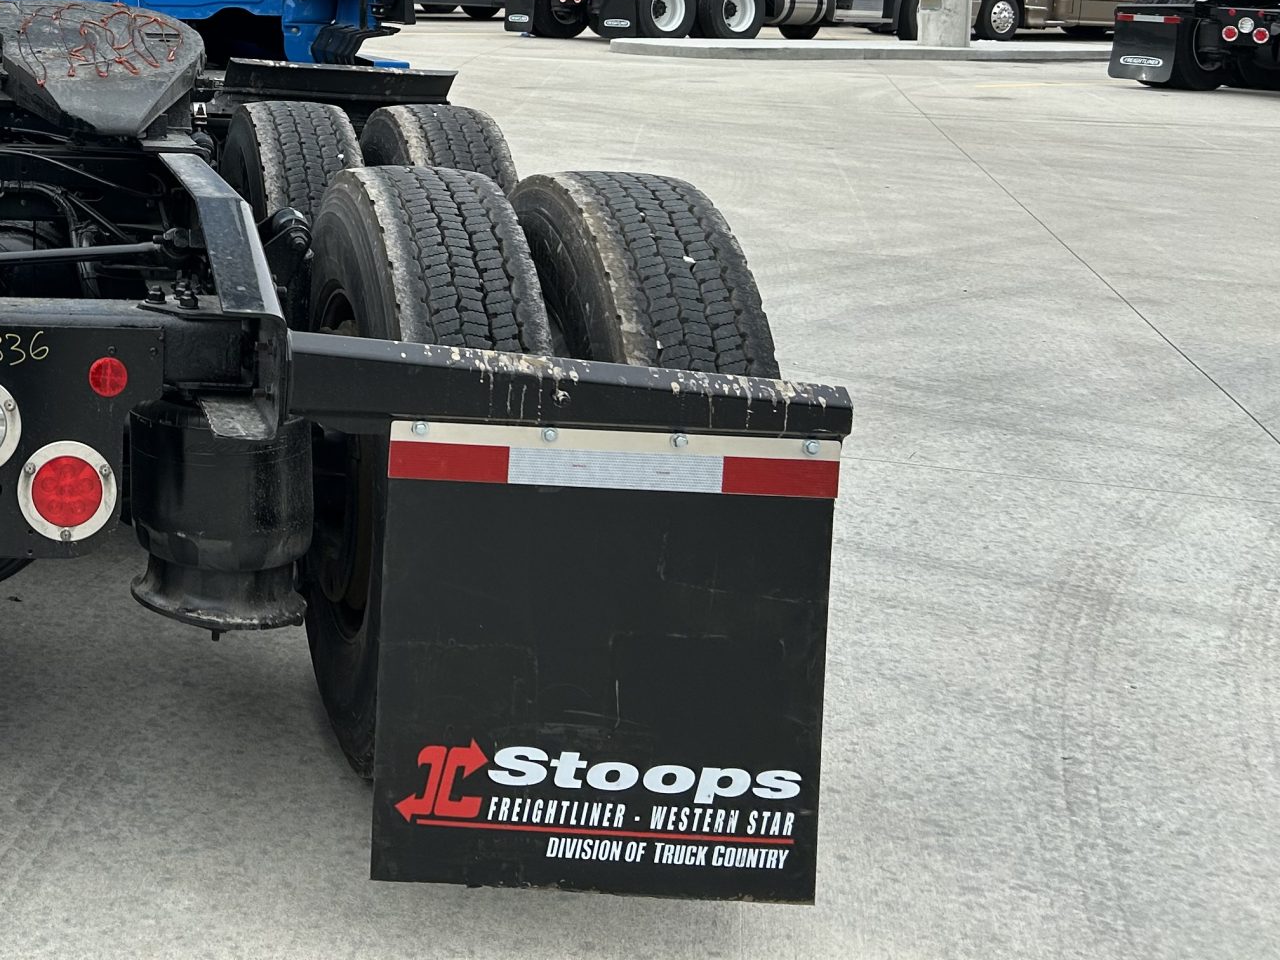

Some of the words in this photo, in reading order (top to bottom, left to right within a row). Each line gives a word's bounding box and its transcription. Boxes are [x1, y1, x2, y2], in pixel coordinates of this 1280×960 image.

[487, 745, 803, 804] Stoops
[487, 796, 626, 828] FREIGHTLINER
[650, 805, 738, 835] WESTERN
[746, 810, 795, 836] STAR
[546, 837, 621, 861] DIVISION
[625, 841, 646, 863] OF
[653, 842, 707, 867] TRUCK
[712, 845, 789, 870] COUNTRY
